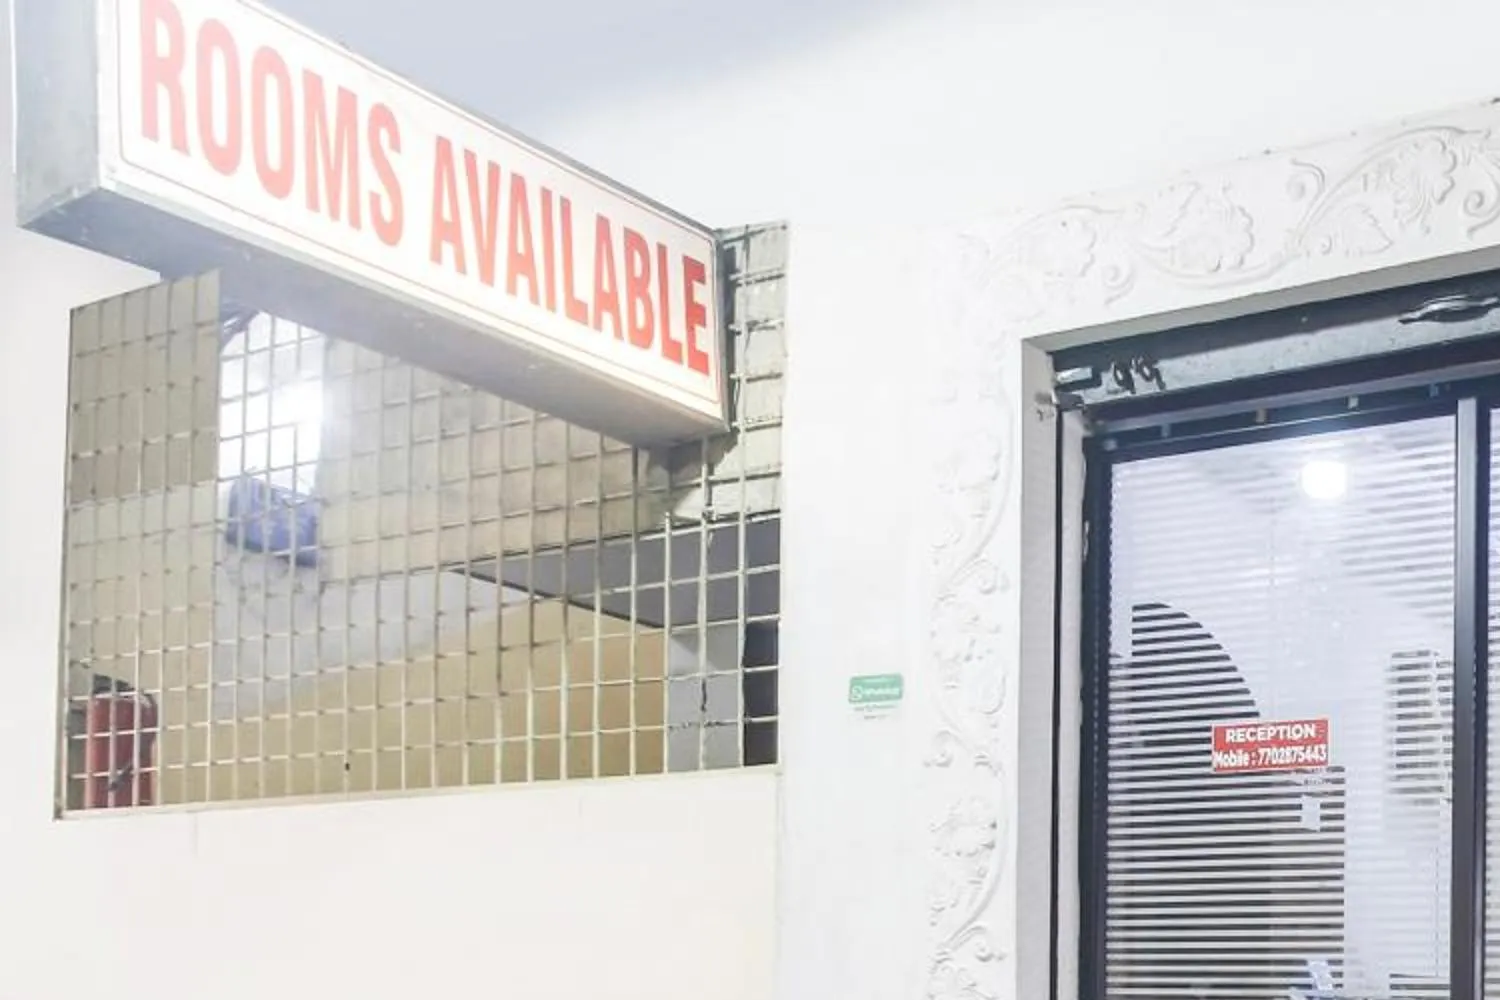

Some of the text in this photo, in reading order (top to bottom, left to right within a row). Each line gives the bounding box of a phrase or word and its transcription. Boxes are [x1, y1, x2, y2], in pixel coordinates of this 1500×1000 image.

[141, 0, 710, 375] ROOMS AVAILABLE
[1226, 724, 1316, 743] RECEPTION
[1213, 749, 1249, 768] Mobile
